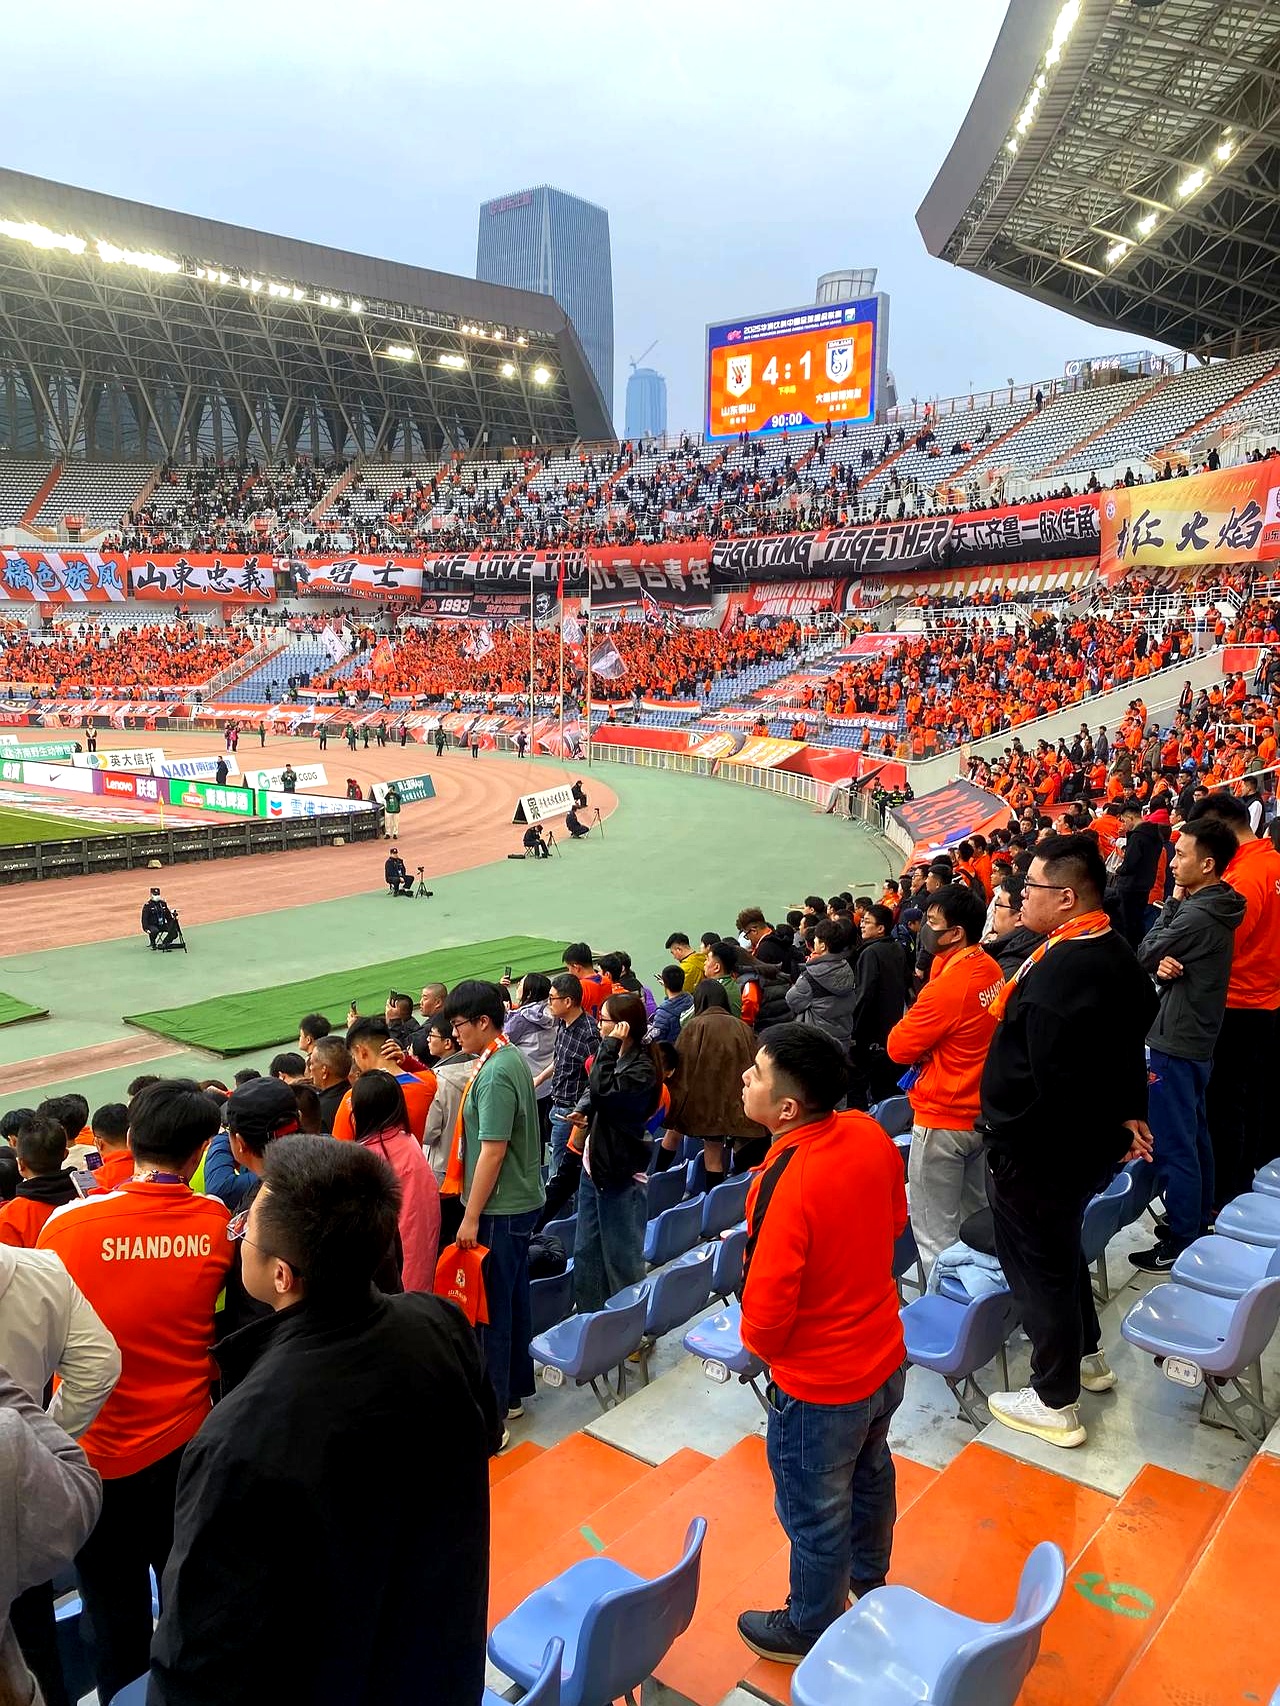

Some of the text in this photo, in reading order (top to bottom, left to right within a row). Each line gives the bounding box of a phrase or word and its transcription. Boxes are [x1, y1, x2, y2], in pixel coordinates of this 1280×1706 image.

[762, 356, 779, 385] 4
[800, 350, 811, 380] 1
[771, 412, 803, 428] 90:00
[951, 503, 1099, 552] 天下齐鲁一脉传承
[711, 518, 951, 578] FIGHTING TOGETHER
[136, 557, 272, 599] 山東忠義
[433, 552, 471, 580] WE
[797, 580, 835, 599] ULTRAS
[109, 752, 156, 767] 英大信托
[161, 762, 196, 778] NARI
[105, 777, 133, 792] Lenovo
[101, 1233, 211, 1261] SHANDONG
